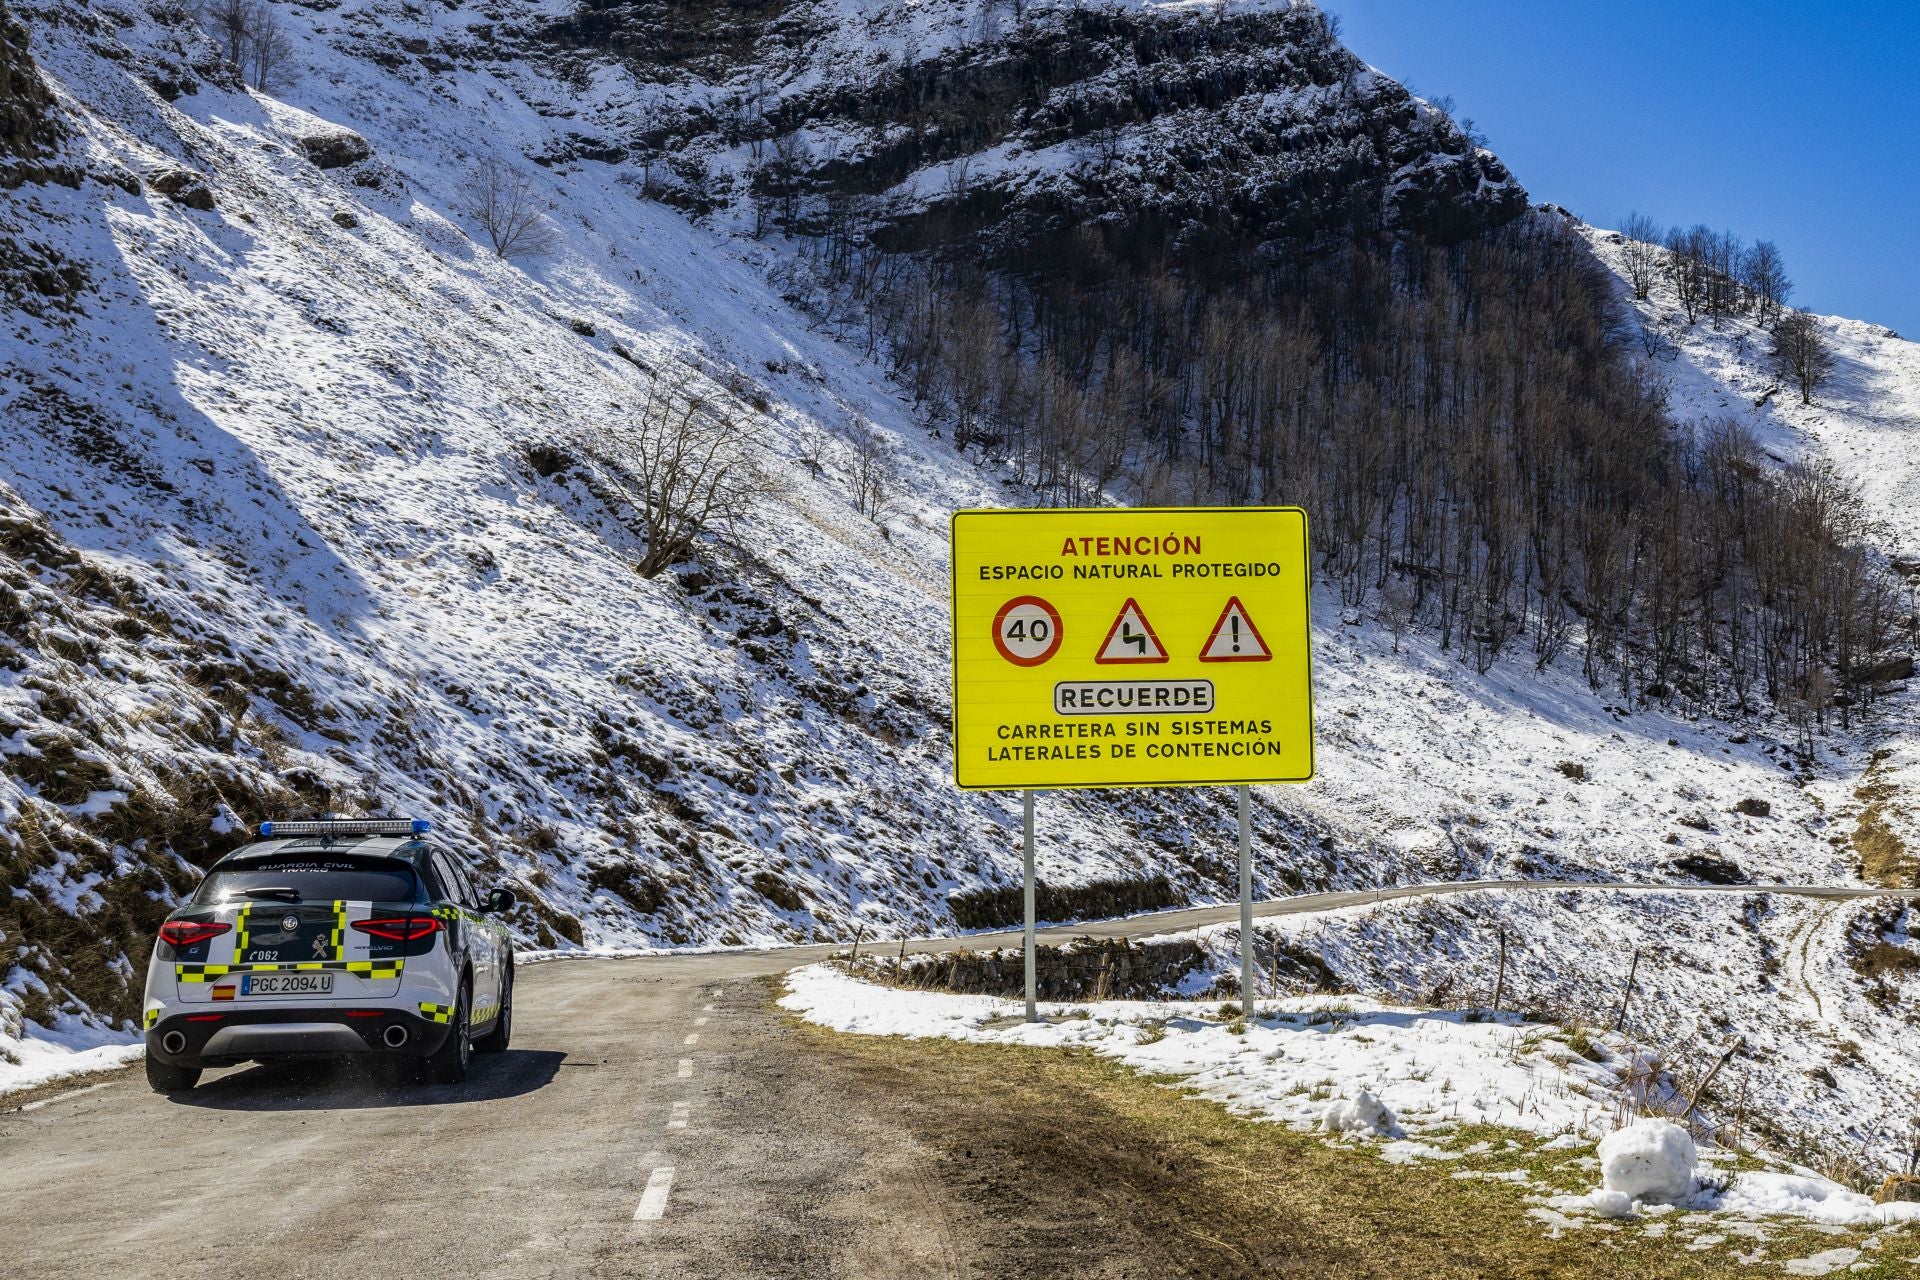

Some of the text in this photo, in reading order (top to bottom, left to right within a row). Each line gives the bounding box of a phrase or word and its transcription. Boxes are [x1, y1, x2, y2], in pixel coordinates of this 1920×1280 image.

[1061, 533, 1201, 557] ATENCIÓN
[979, 563, 1281, 580] ESPACIO NATURAL PROTEGIDO
[1006, 620, 1049, 643] 40
[1061, 687, 1208, 708] RECUERDE
[997, 720, 1272, 740] CARRETERA SIN SISTEMAS
[988, 738, 1281, 762] LATERALES DE CONTENCIÓN
[258, 862, 318, 871] GUARDIA
[257, 950, 279, 961] 062
[250, 978, 279, 992] PGC
[281, 977, 318, 991] 2094
[321, 976, 331, 990] U
